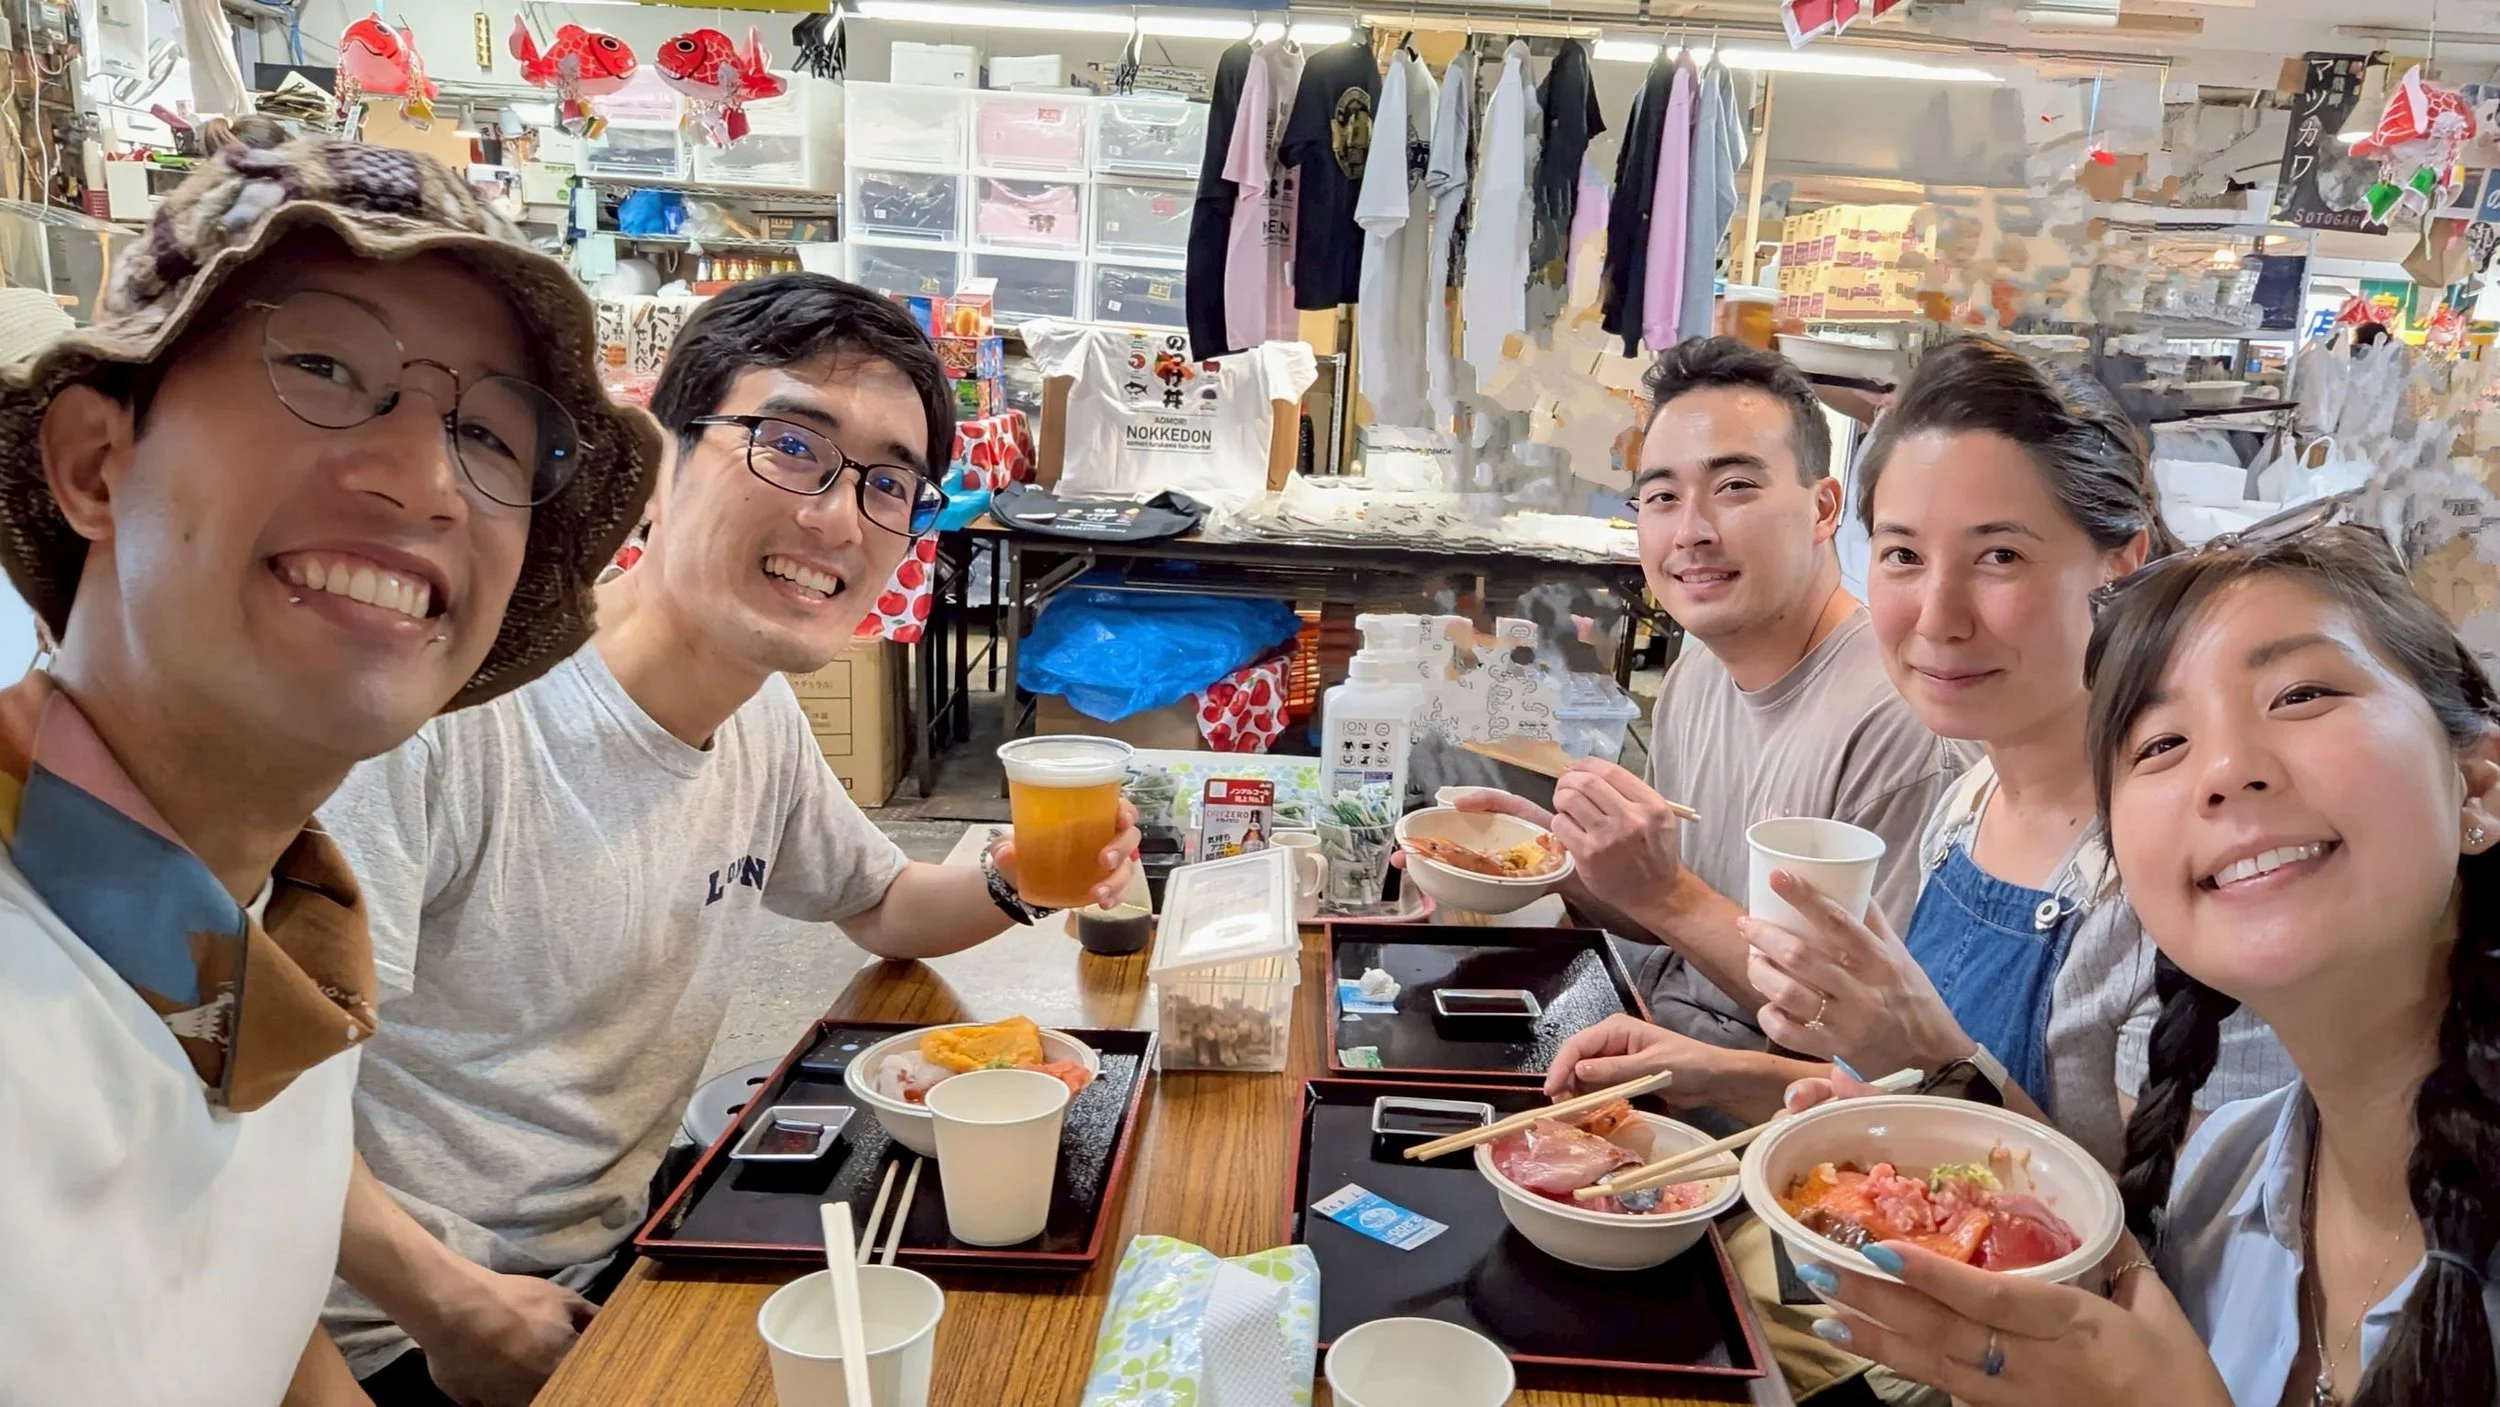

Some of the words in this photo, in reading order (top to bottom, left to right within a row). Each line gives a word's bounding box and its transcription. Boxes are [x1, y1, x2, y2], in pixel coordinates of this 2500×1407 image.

[2291, 59, 2334, 181] マツカワ
[1154, 416, 1187, 426] AOMORI
[1126, 425, 1212, 444] NOKKEDON
[1342, 721, 1368, 732] ION
